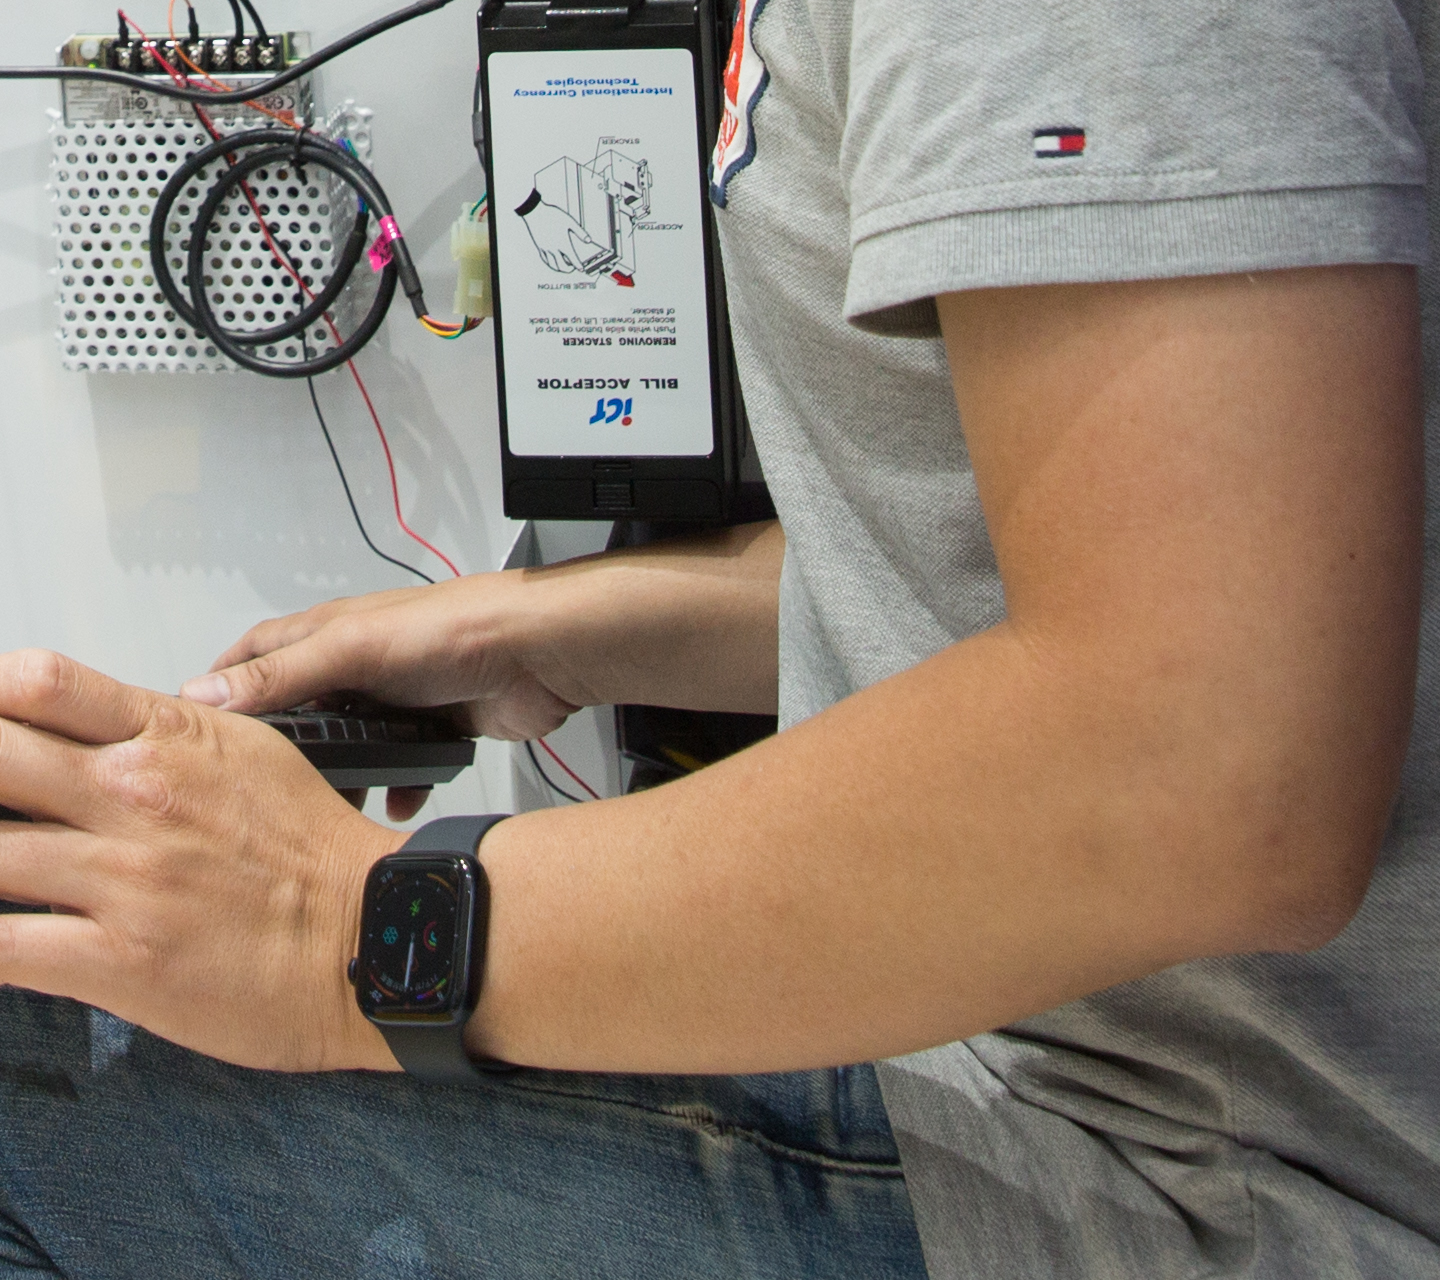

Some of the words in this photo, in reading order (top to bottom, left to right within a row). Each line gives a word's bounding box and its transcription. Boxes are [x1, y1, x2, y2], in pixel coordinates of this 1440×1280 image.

[546, 77, 639, 87] Technologies
[513, 88, 576, 98] Currency
[582, 87, 673, 97] International
[602, 137, 640, 145] STACKER
[573, 282, 596, 290] SLIDE
[630, 307, 664, 316] stacker.
[666, 308, 675, 316] of
[529, 317, 549, 325] back
[552, 317, 568, 325] and
[570, 315, 582, 323] up
[583, 316, 597, 325] Lift
[600, 316, 635, 325] forward.
[637, 315, 675, 325] acceptor
[535, 326, 544, 334] of
[546, 324, 560, 333] top
[575, 325, 604, 334] button
[605, 325, 626, 334] slide
[628, 325, 652, 334] white
[653, 325, 676, 334] Push
[562, 337, 612, 346] STACKER
[619, 337, 677, 346] REMOVING
[537, 378, 630, 390] ACCEPTOR
[639, 378, 678, 390] BILL
